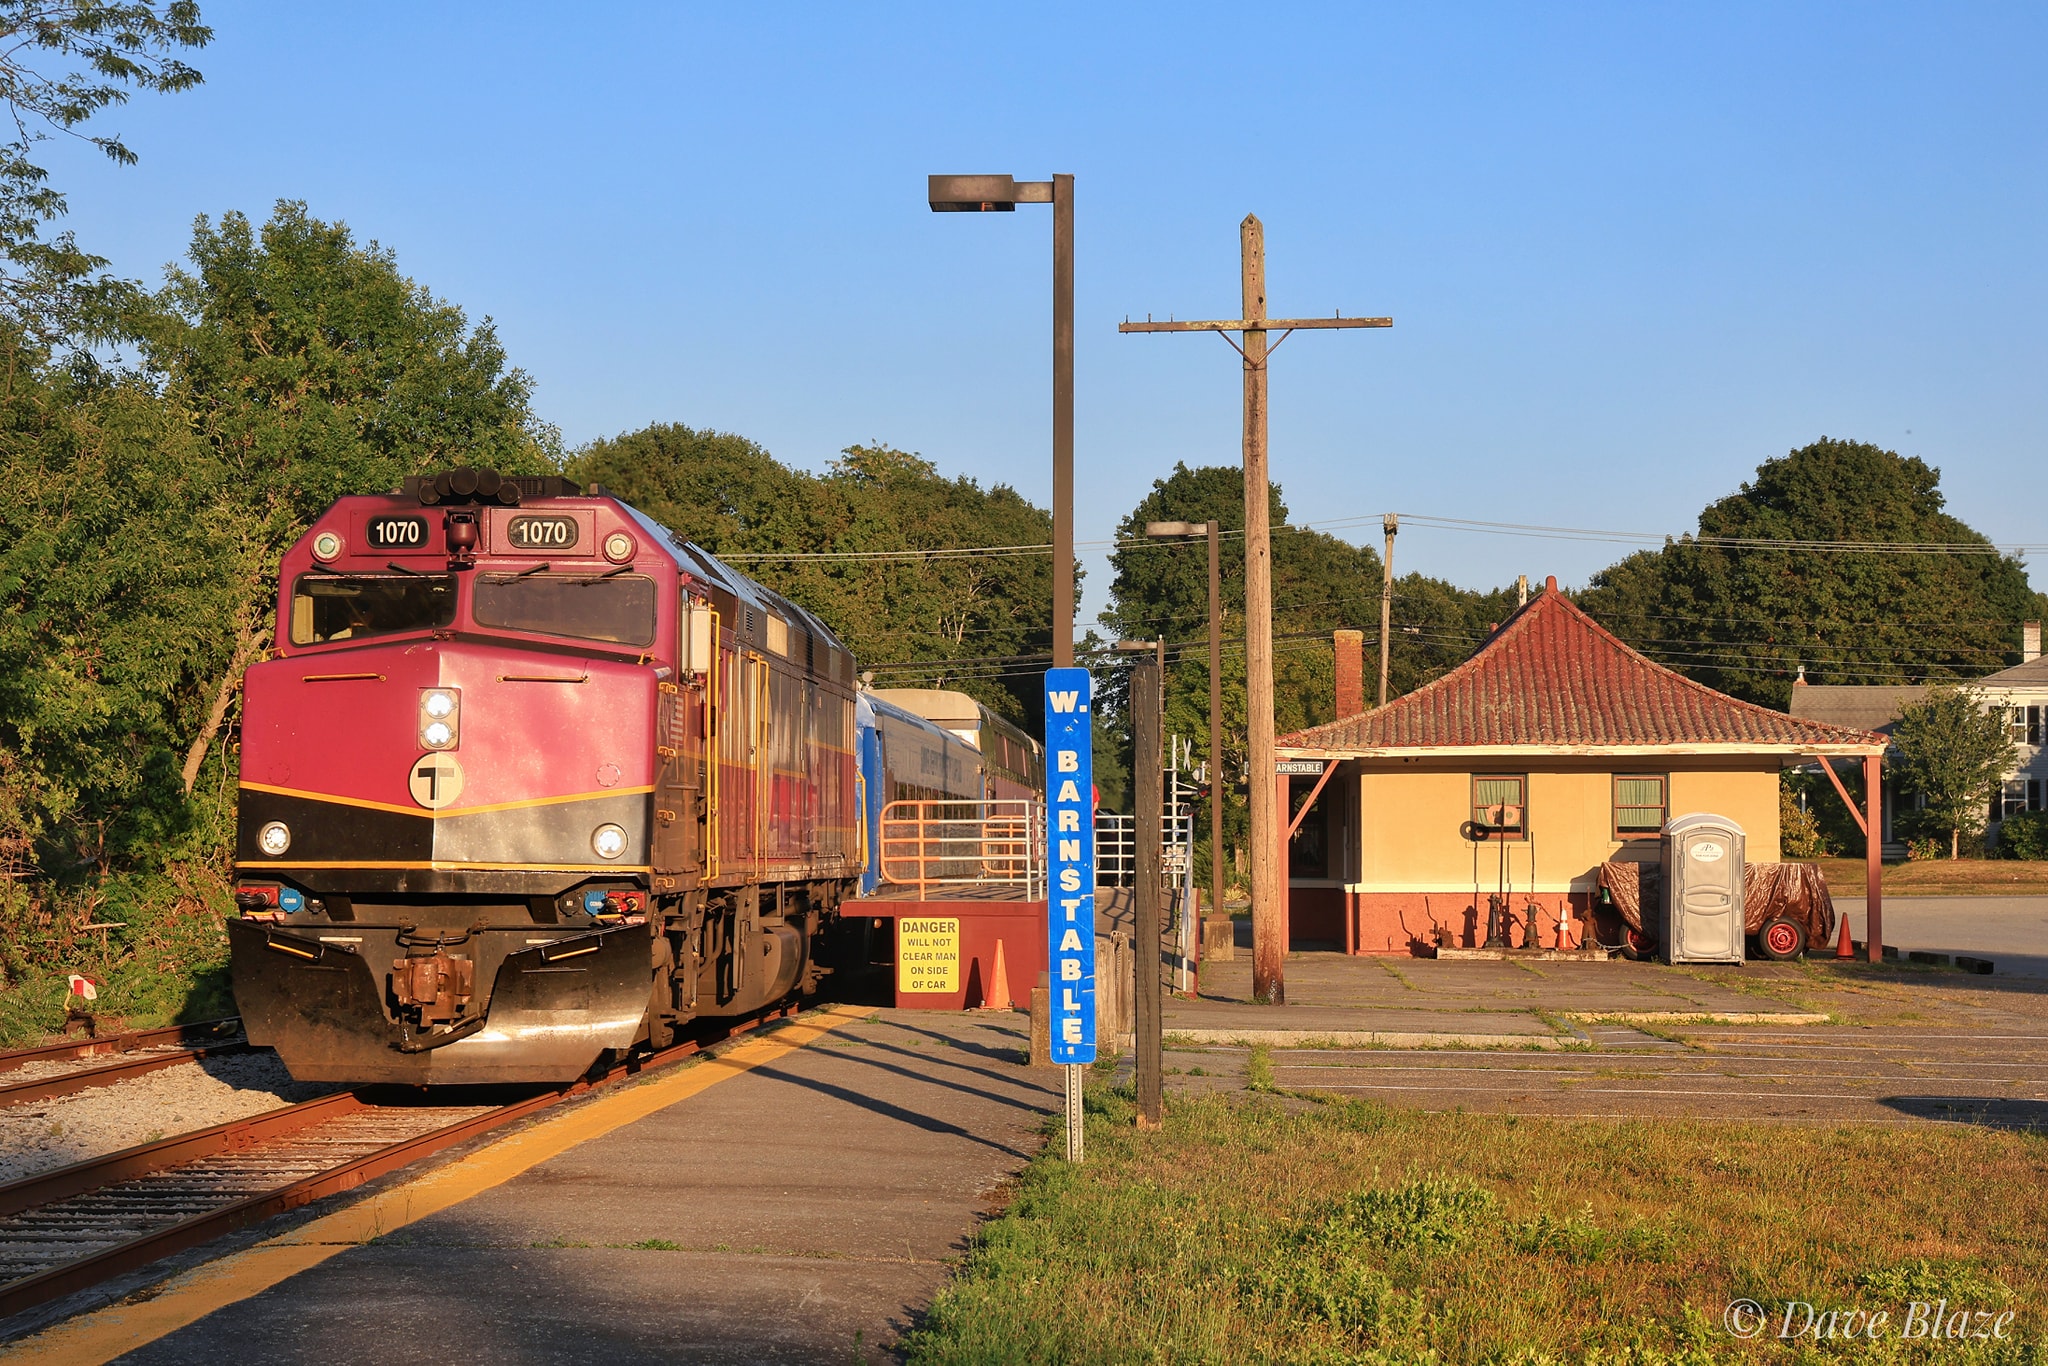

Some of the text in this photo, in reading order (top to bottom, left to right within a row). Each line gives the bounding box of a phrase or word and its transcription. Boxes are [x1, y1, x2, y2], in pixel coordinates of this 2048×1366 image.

[376, 521, 420, 543] 1070
[519, 521, 567, 543] 1070
[1048, 691, 1088, 713] W.
[1276, 763, 1321, 773] ARNSTABLE
[417, 767, 455, 801] T
[902, 921, 956, 933] DANGER
[907, 938, 951, 947] WILL NOT
[902, 952, 956, 961] CLEAR MAN
[911, 966, 949, 975] ON SIDE
[912, 980, 946, 989] OF CAR
